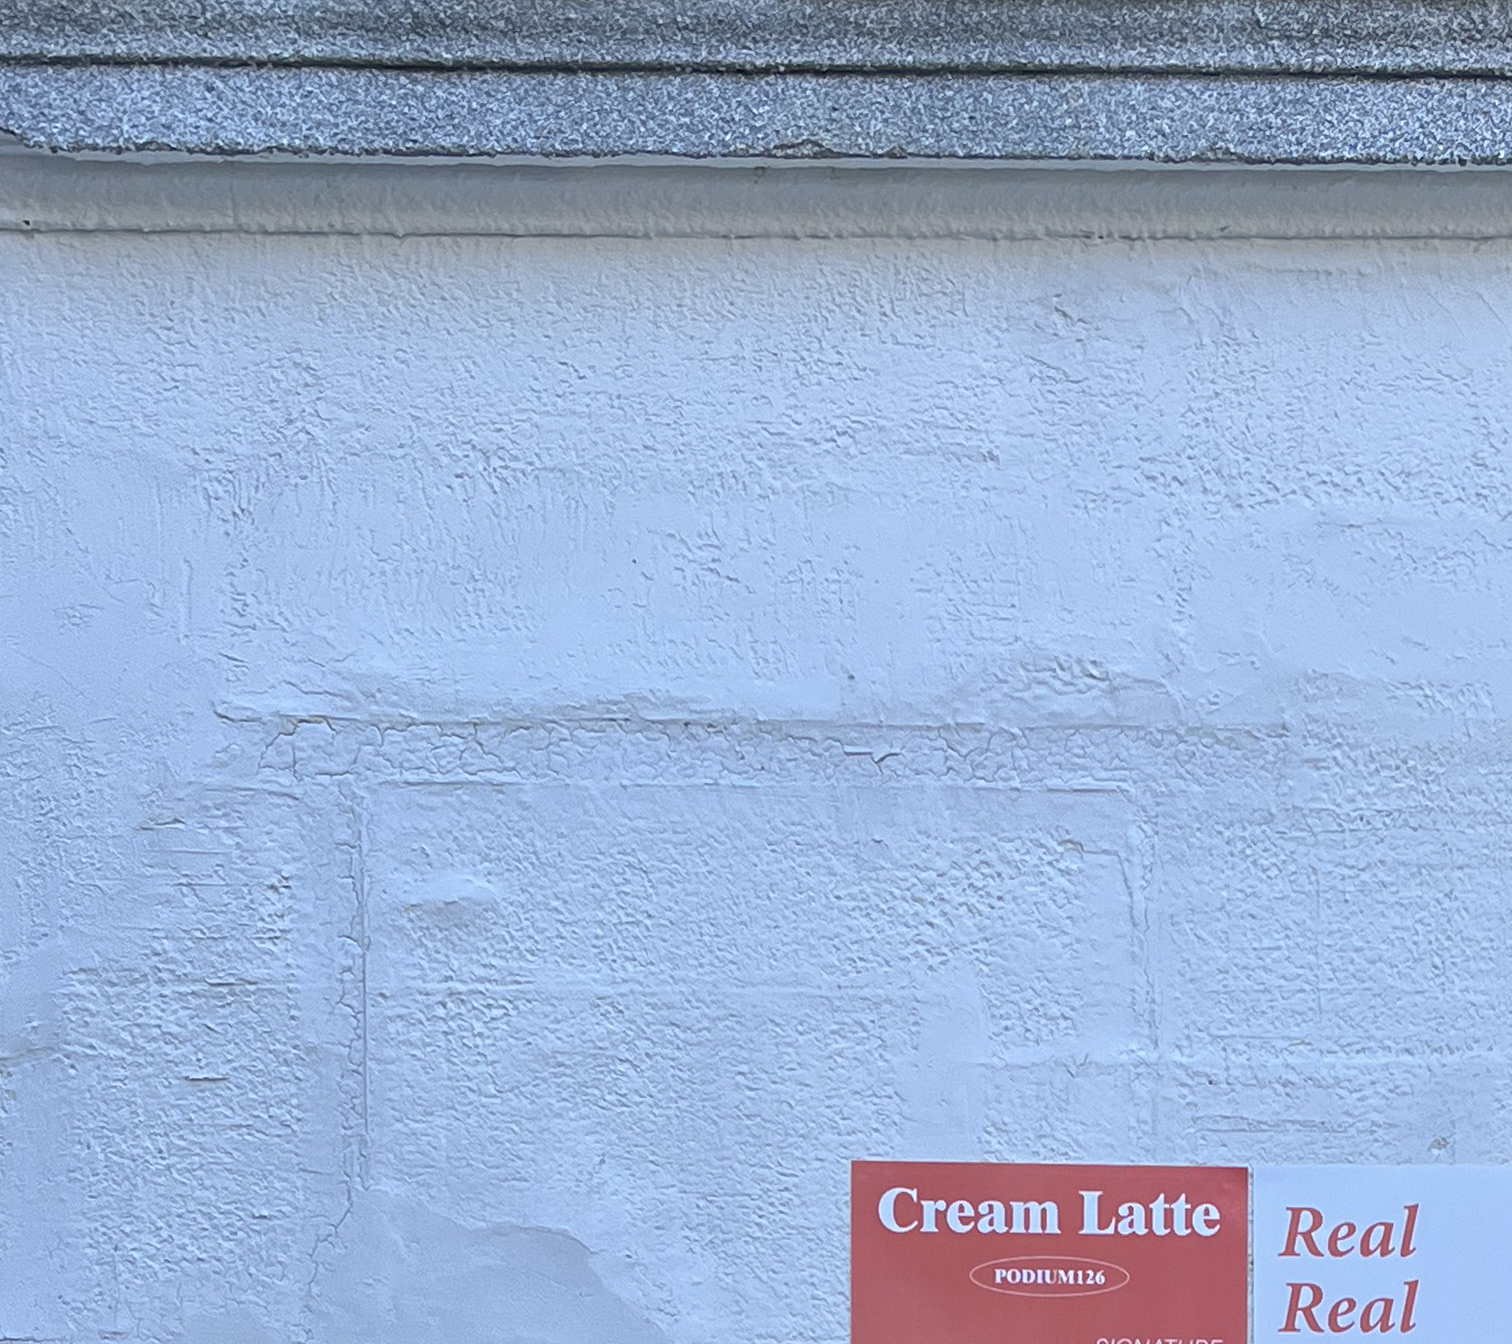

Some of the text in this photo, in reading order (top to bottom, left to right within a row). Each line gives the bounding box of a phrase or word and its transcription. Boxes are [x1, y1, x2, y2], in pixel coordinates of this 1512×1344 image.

[879, 1188, 1220, 1236] Cream Latte
[1278, 1204, 1418, 1257] Real
[994, 1269, 1106, 1286] PODIUM126
[1278, 1280, 1418, 1333] Real
